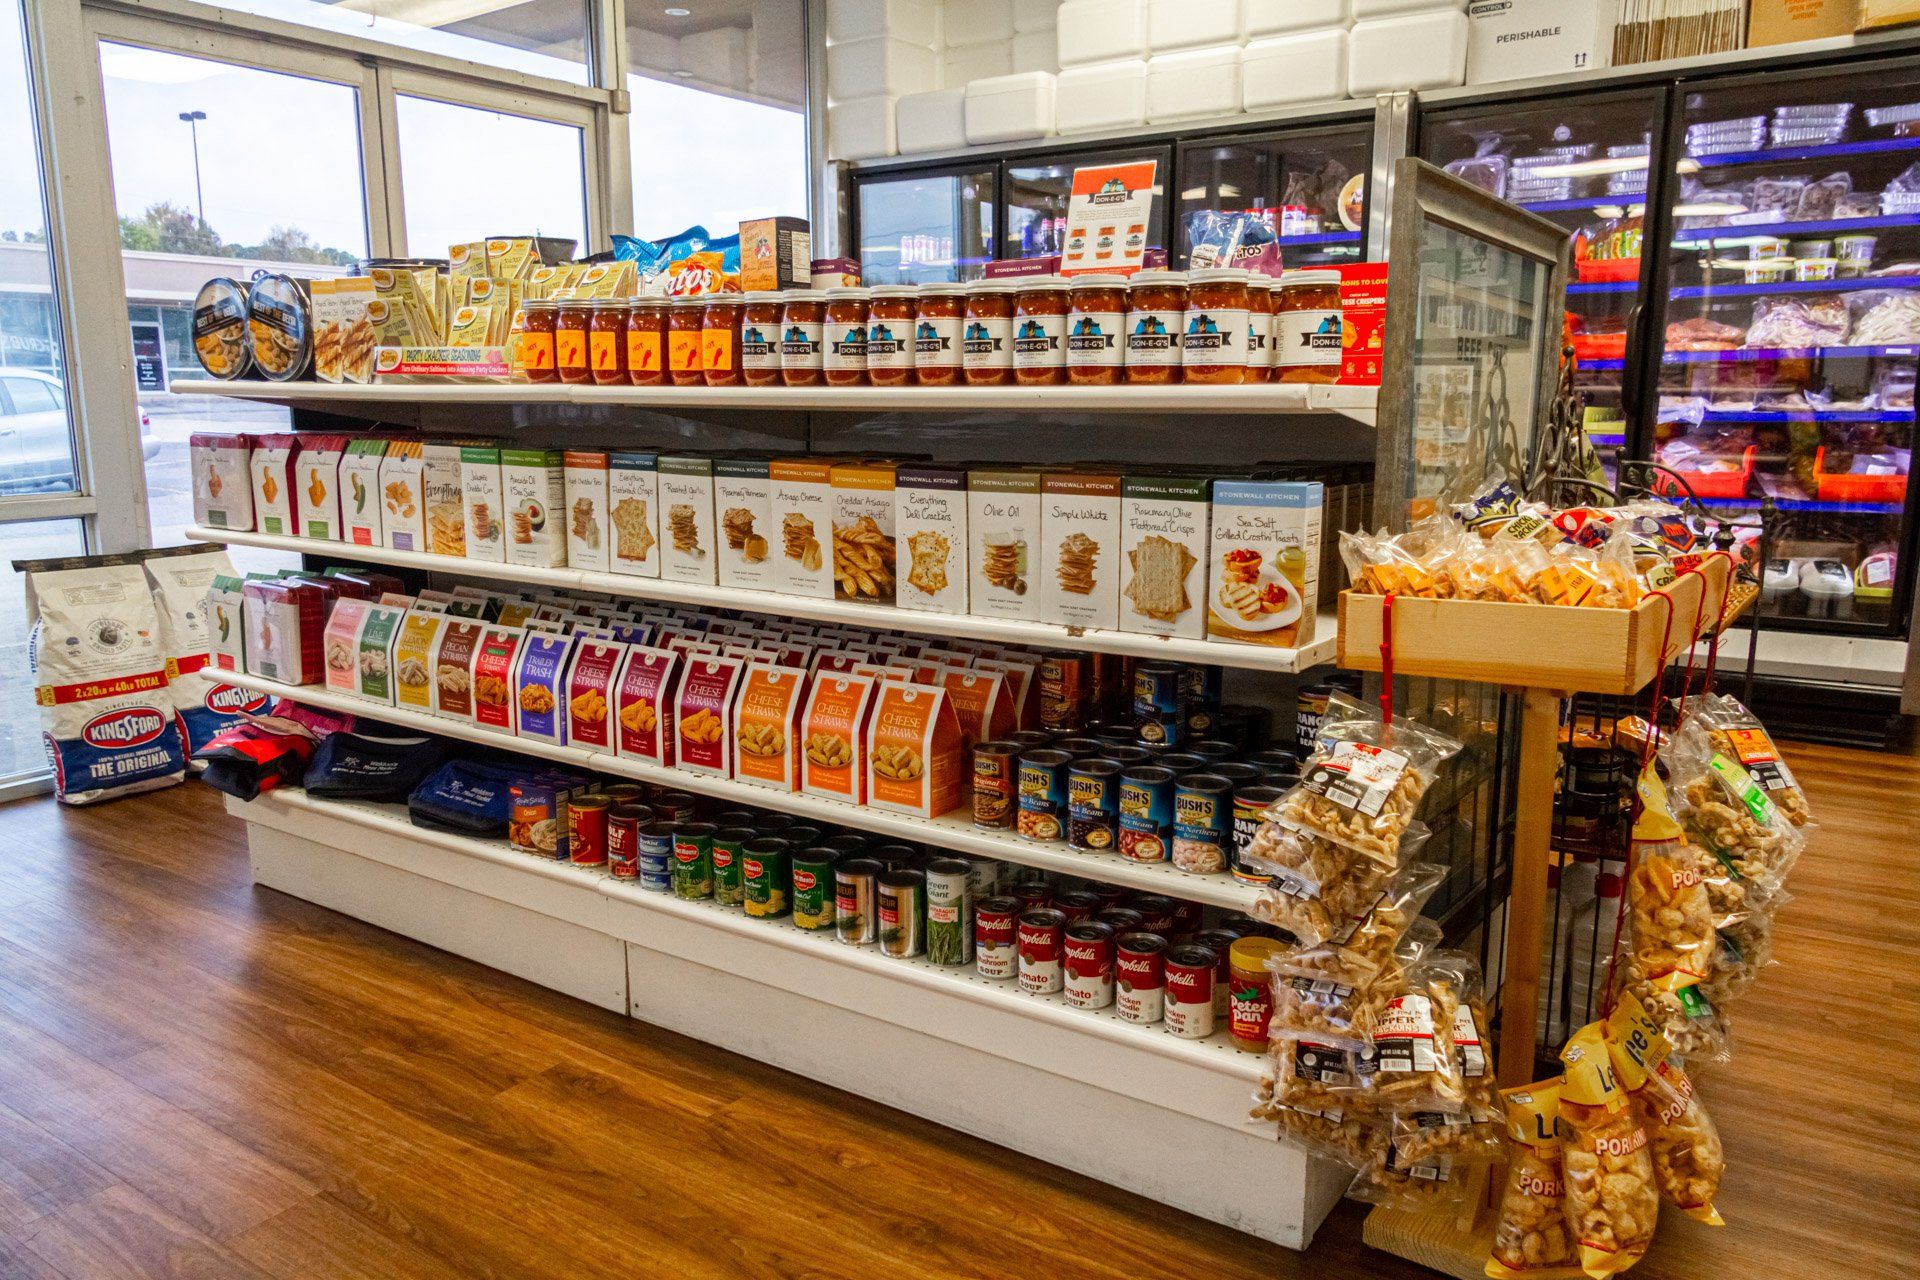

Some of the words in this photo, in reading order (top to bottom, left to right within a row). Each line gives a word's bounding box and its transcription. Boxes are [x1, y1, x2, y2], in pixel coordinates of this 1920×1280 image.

[1496, 27, 1561, 43] PERISHABLE
[1070, 340, 1104, 348] DON-E-G'S
[1131, 339, 1169, 347] DON-E-G'S
[406, 350, 423, 361] PARTY
[424, 350, 450, 361] CRACKER
[450, 350, 481, 361] SEASONING
[456, 365, 475, 375] Amazing
[475, 365, 488, 375] Party
[661, 463, 685, 471] STONEWALL
[619, 472, 645, 486] Everything
[834, 476, 865, 484] STONEWALL
[664, 482, 688, 495] Roasted
[1127, 485, 1167, 493] STONEWALL
[1168, 487, 1199, 495] KITCHEN
[776, 489, 800, 506] Asiago
[800, 491, 823, 503] Cheese
[836, 494, 864, 506] Cheddar
[865, 496, 891, 511] Asiago
[909, 492, 947, 512] Everything
[1219, 491, 1264, 500] STONEWALL
[1265, 493, 1300, 501] KITCHEN
[840, 506, 861, 518] Cheese
[903, 506, 921, 519] Deli
[921, 509, 952, 521] Crackers
[983, 503, 1005, 517] Olive
[1008, 505, 1020, 518] Oil
[1052, 505, 1079, 522] Simple
[1080, 510, 1109, 521] White
[1132, 502, 1172, 522] Rosemary
[1172, 506, 1192, 519] Olive
[1130, 518, 1167, 532] Flatbread
[1169, 521, 1195, 537] Crisps
[1236, 515, 1253, 528] Sea
[1254, 516, 1277, 530] Salt
[1215, 527, 1241, 540] Grilled
[1242, 529, 1272, 542] Crostini
[1271, 530, 1300, 543] Toasts
[444, 642, 469, 653] PECAN
[441, 651, 469, 663] STRAWS
[481, 654, 508, 666] CHEESE
[528, 655, 554, 668] TRAILER
[525, 663, 552, 679] TRASH
[578, 665, 608, 679] CHEESE
[134, 676, 160, 689] TOTAL
[575, 676, 605, 689] STRAWS
[628, 674, 658, 689] CHEESE
[1136, 677, 1153, 691] SH'S
[624, 685, 655, 699] STRAWS
[688, 683, 723, 698] CHEESE
[685, 694, 720, 708] STRAWS
[748, 692, 783, 707] CHEESE
[952, 698, 980, 711] HEESE
[745, 703, 781, 719] STRAWS
[816, 702, 850, 717] CHEESE
[813, 714, 849, 729] STRAWS
[882, 712, 922, 728] CHEESE
[90, 714, 161, 742] KINGSFORD
[879, 724, 919, 740] STRAWS
[90, 764, 114, 779] THE
[117, 750, 172, 774] ORIGINAL
[975, 760, 998, 772] BUSH'S
[1069, 779, 1101, 795] BUSH'S
[1028, 797, 1050, 807] Beans
[1177, 797, 1212, 814] BUSH'S
[1081, 806, 1103, 817] Beans
[1132, 821, 1153, 830] Beans
[1185, 826, 1218, 837] Northern
[799, 875, 815, 884] Monte
[928, 878, 949, 890] Green
[928, 889, 949, 899] Giant
[980, 966, 1003, 976] SOUP
[1231, 994, 1268, 1013] Peter
